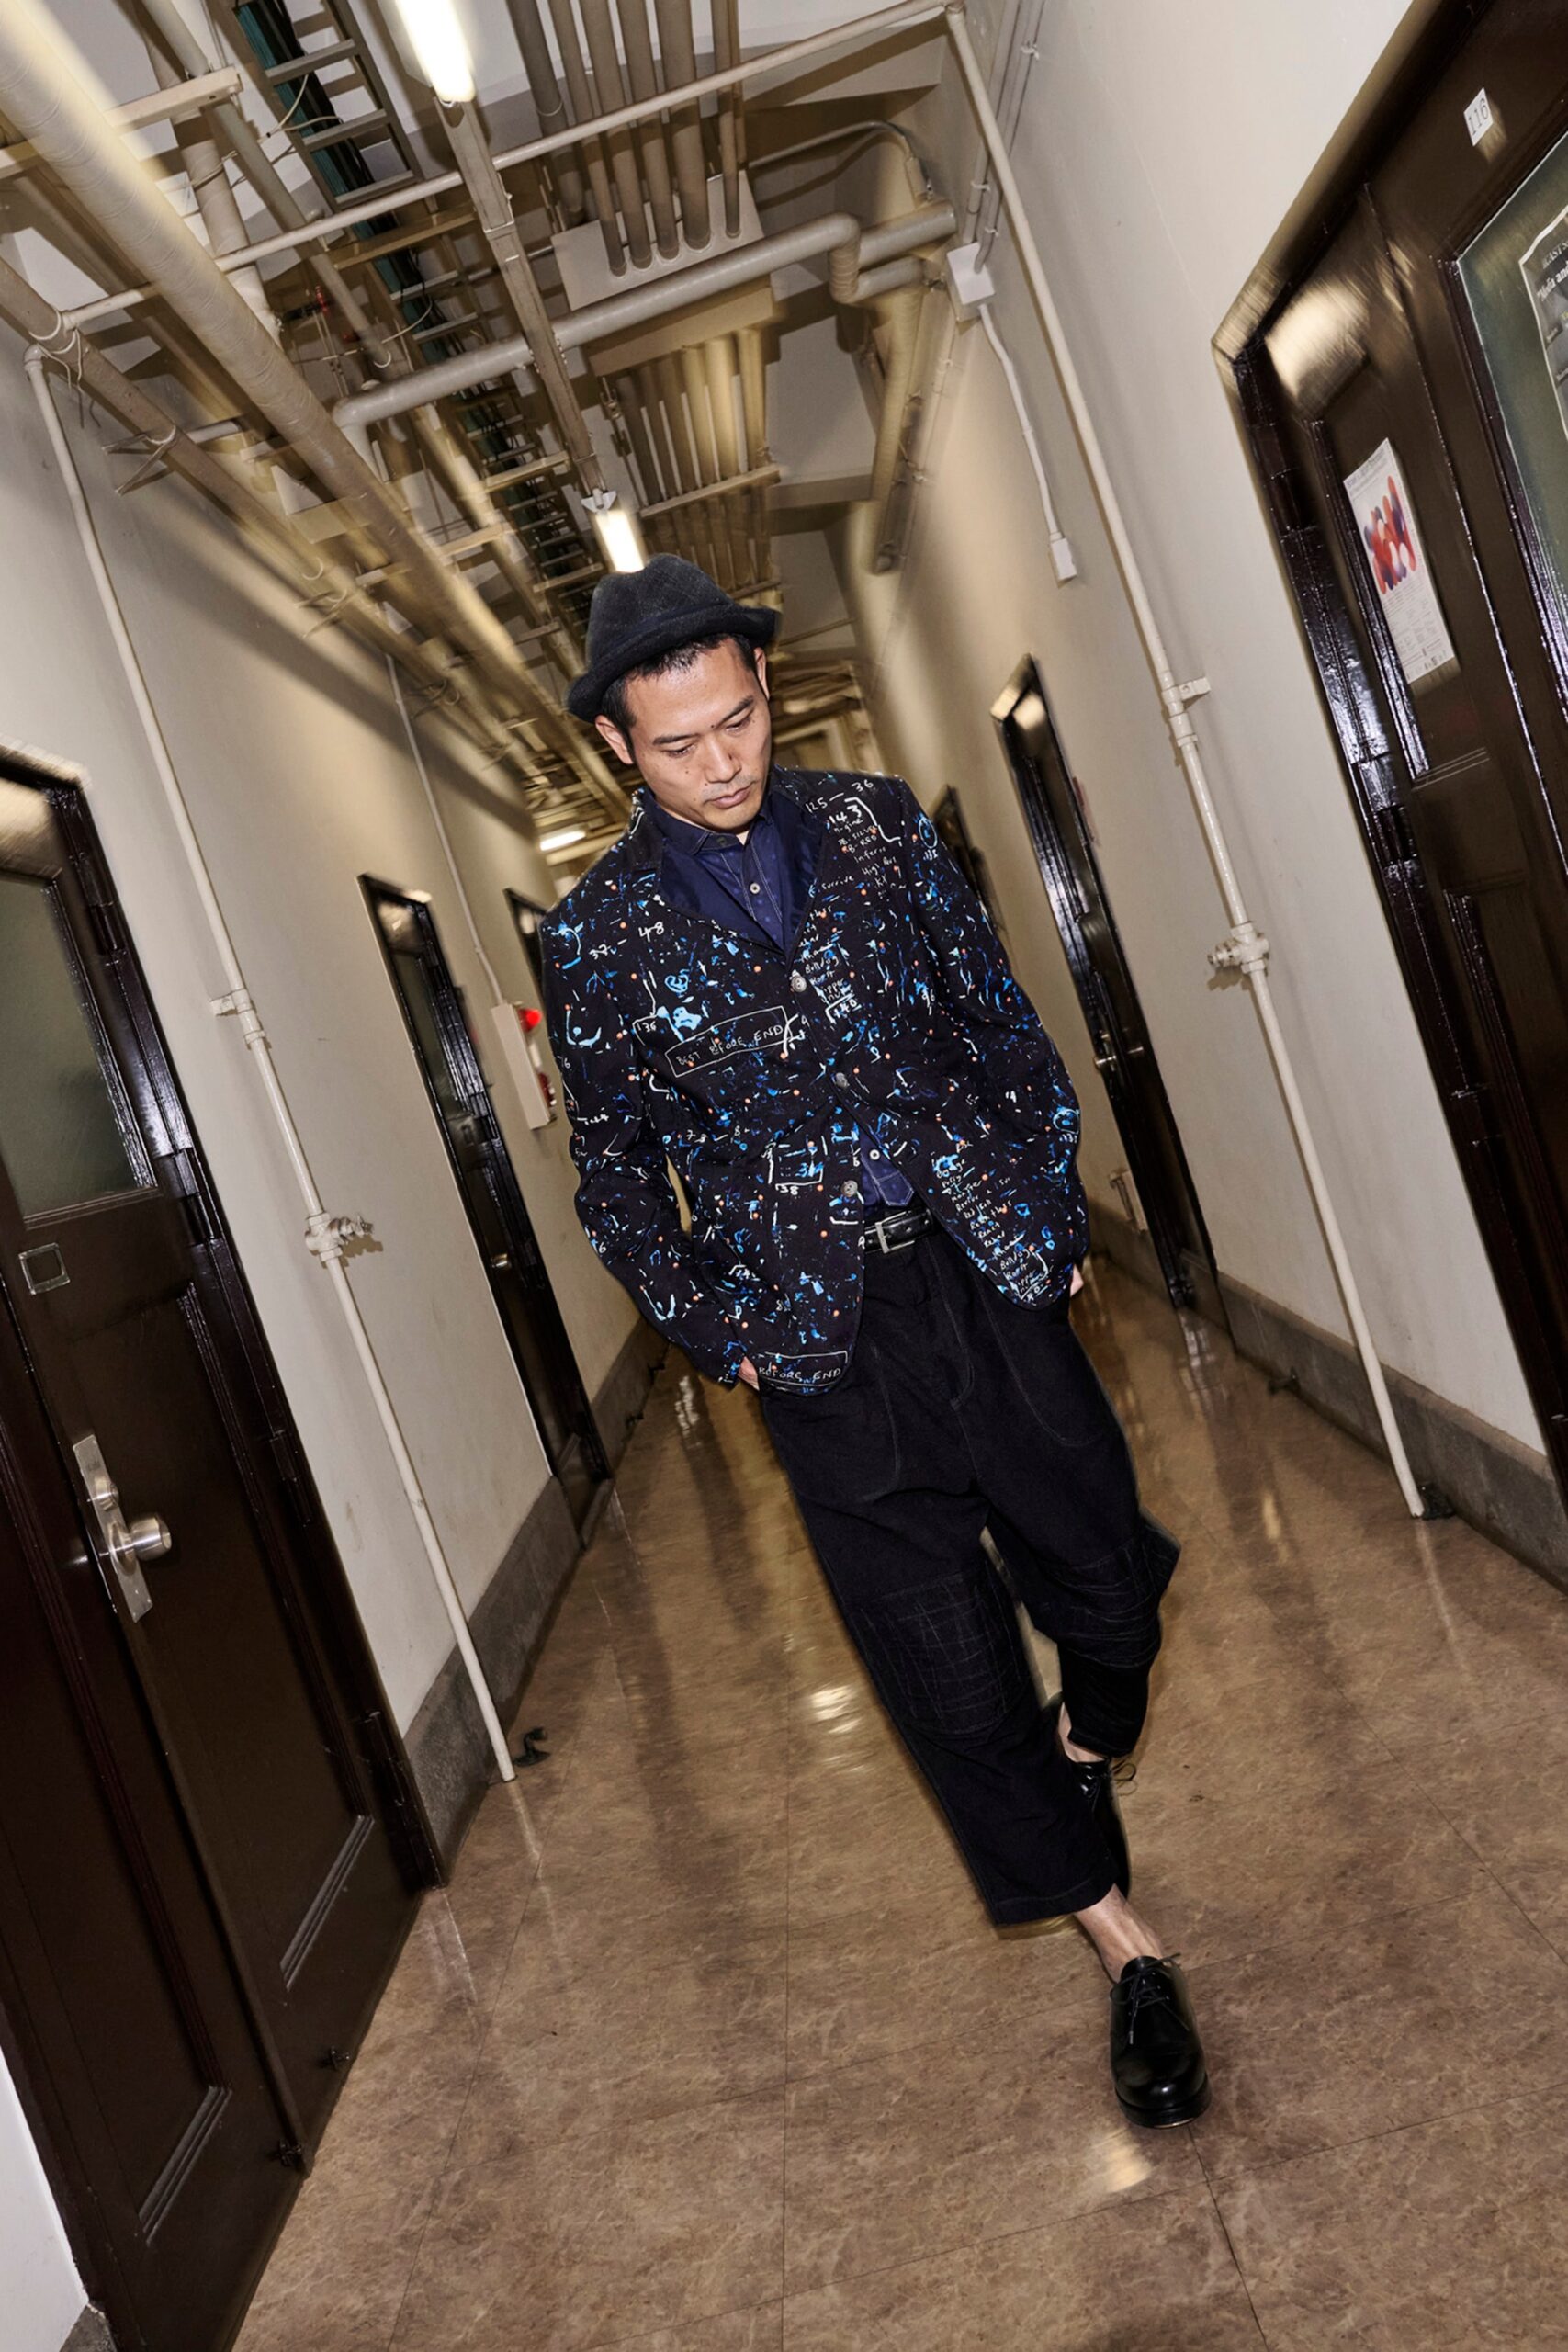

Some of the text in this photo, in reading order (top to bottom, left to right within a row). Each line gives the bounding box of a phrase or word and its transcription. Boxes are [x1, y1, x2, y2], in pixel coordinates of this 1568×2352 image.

[1468, 97, 1489, 136] 116
[805, 797, 828, 813] 125
[638, 922, 664, 943] 48
[753, 1023, 784, 1043] END
[813, 1368, 841, 1380] END
